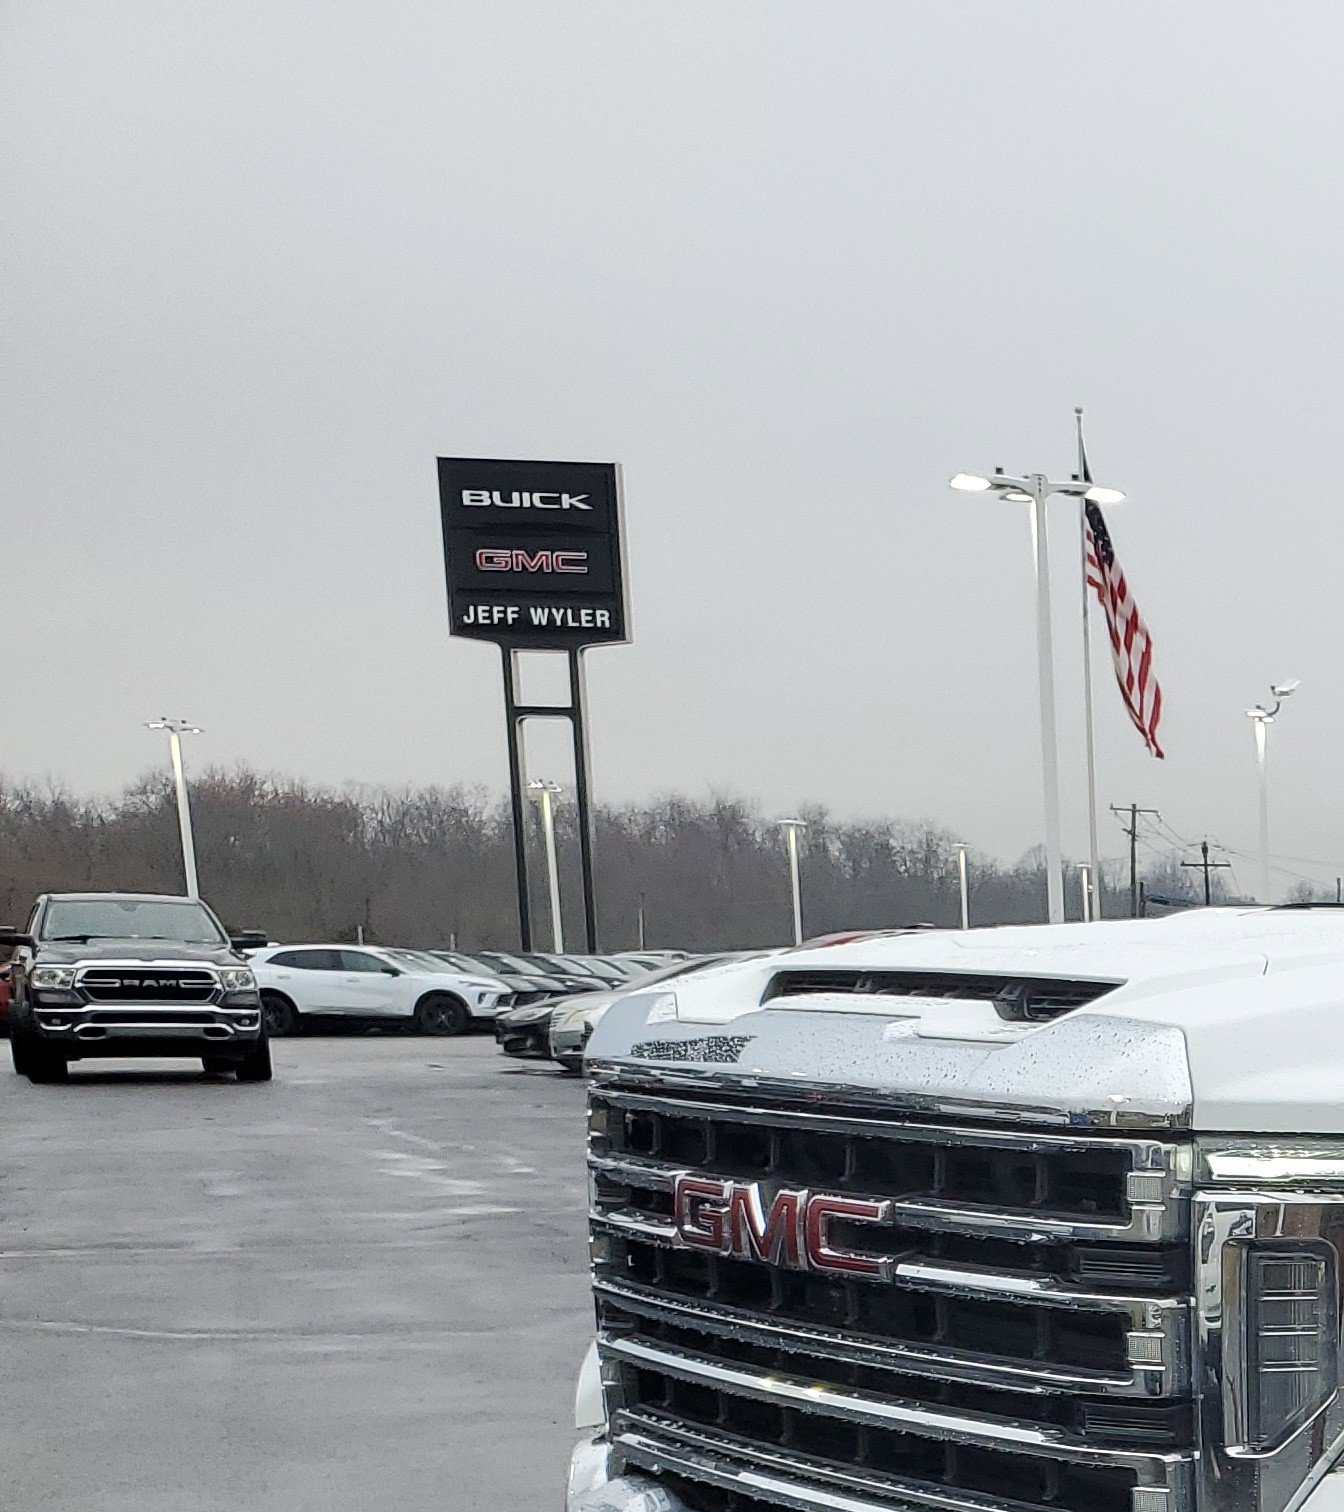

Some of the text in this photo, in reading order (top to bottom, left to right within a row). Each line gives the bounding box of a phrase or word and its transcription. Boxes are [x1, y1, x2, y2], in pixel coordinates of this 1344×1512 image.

[462, 489, 593, 510] BUICK
[475, 549, 588, 573] GMC
[462, 605, 611, 628] JEFF WYLER
[122, 979, 177, 988] RAM
[675, 1173, 893, 1283] GMC
